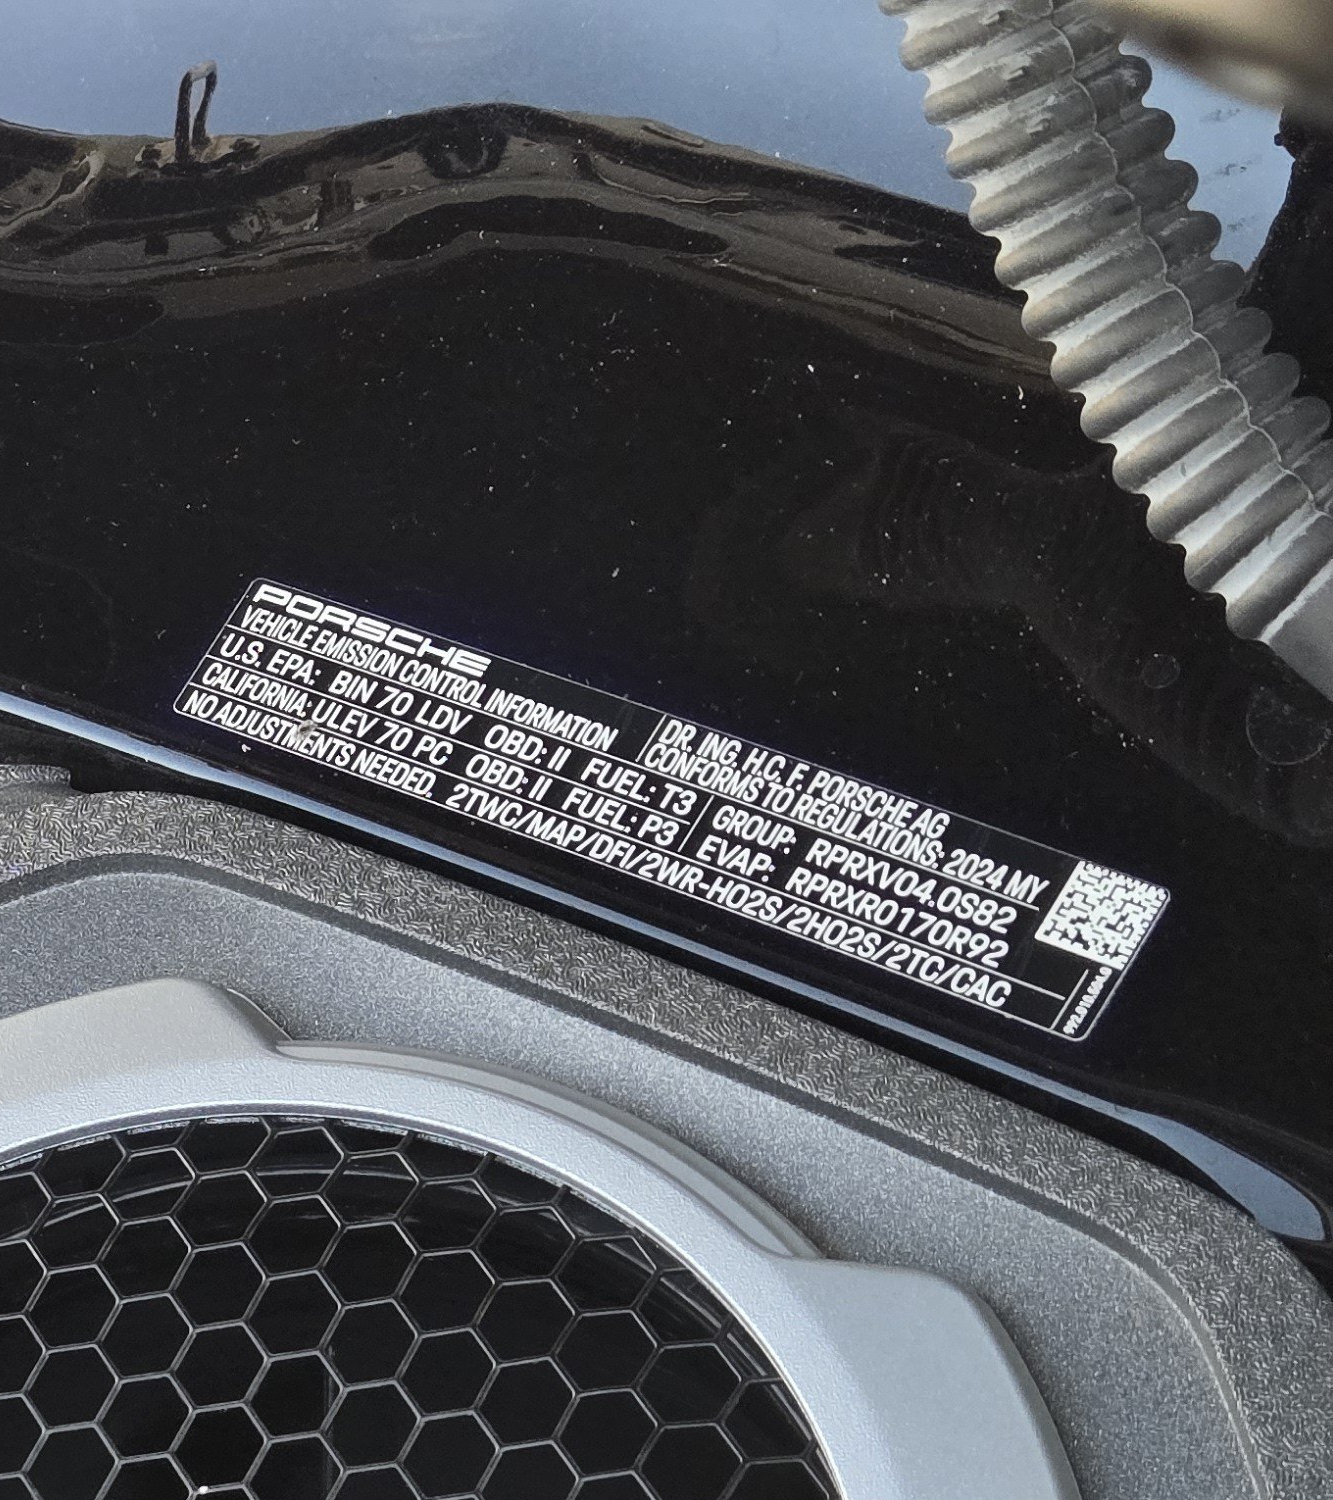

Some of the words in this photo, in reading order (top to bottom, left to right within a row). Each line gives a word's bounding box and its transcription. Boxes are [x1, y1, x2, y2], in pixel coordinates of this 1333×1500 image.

[240, 604, 320, 649] VEHICLE
[310, 628, 405, 679] EMISSION
[393, 659, 487, 712] CONTROL
[483, 687, 619, 752] INFORMATION
[252, 583, 492, 678] PORSCHE
[182, 690, 219, 721] NO
[215, 703, 356, 768] ADJUSTMENTS
[350, 751, 435, 799] NEEDED.
[201, 662, 313, 719] CALIFORNIA:
[308, 698, 381, 738] ULEV
[373, 720, 414, 752] 70
[411, 734, 454, 766] PC
[465, 753, 529, 795] OBD:
[527, 774, 554, 802] II
[560, 786, 638, 834] FUEL:
[636, 813, 680, 847] P3
[219, 632, 265, 669] U.S.
[265, 648, 322, 686] EPA:
[327, 669, 379, 704] BIN
[374, 685, 415, 717] 70
[414, 699, 474, 736] LDV
[483, 724, 548, 765] OBD:
[546, 745, 572, 772] II
[580, 757, 657, 804] FUEL:
[659, 782, 698, 816] T3
[656, 718, 697, 754] DR.
[692, 731, 743, 770] ING.
[738, 747, 787, 786] H.C.
[785, 762, 811, 792] F.
[802, 769, 919, 831] PORSCHE
[905, 808, 951, 843] AG
[638, 742, 770, 807] CONFORMS
[754, 781, 796, 818] TO
[785, 793, 946, 870] REGULATIONS:
[941, 848, 1009, 894] 2024
[999, 869, 1051, 904] MY
[695, 833, 776, 883] EVAP:
[711, 804, 797, 855] GROUP:
